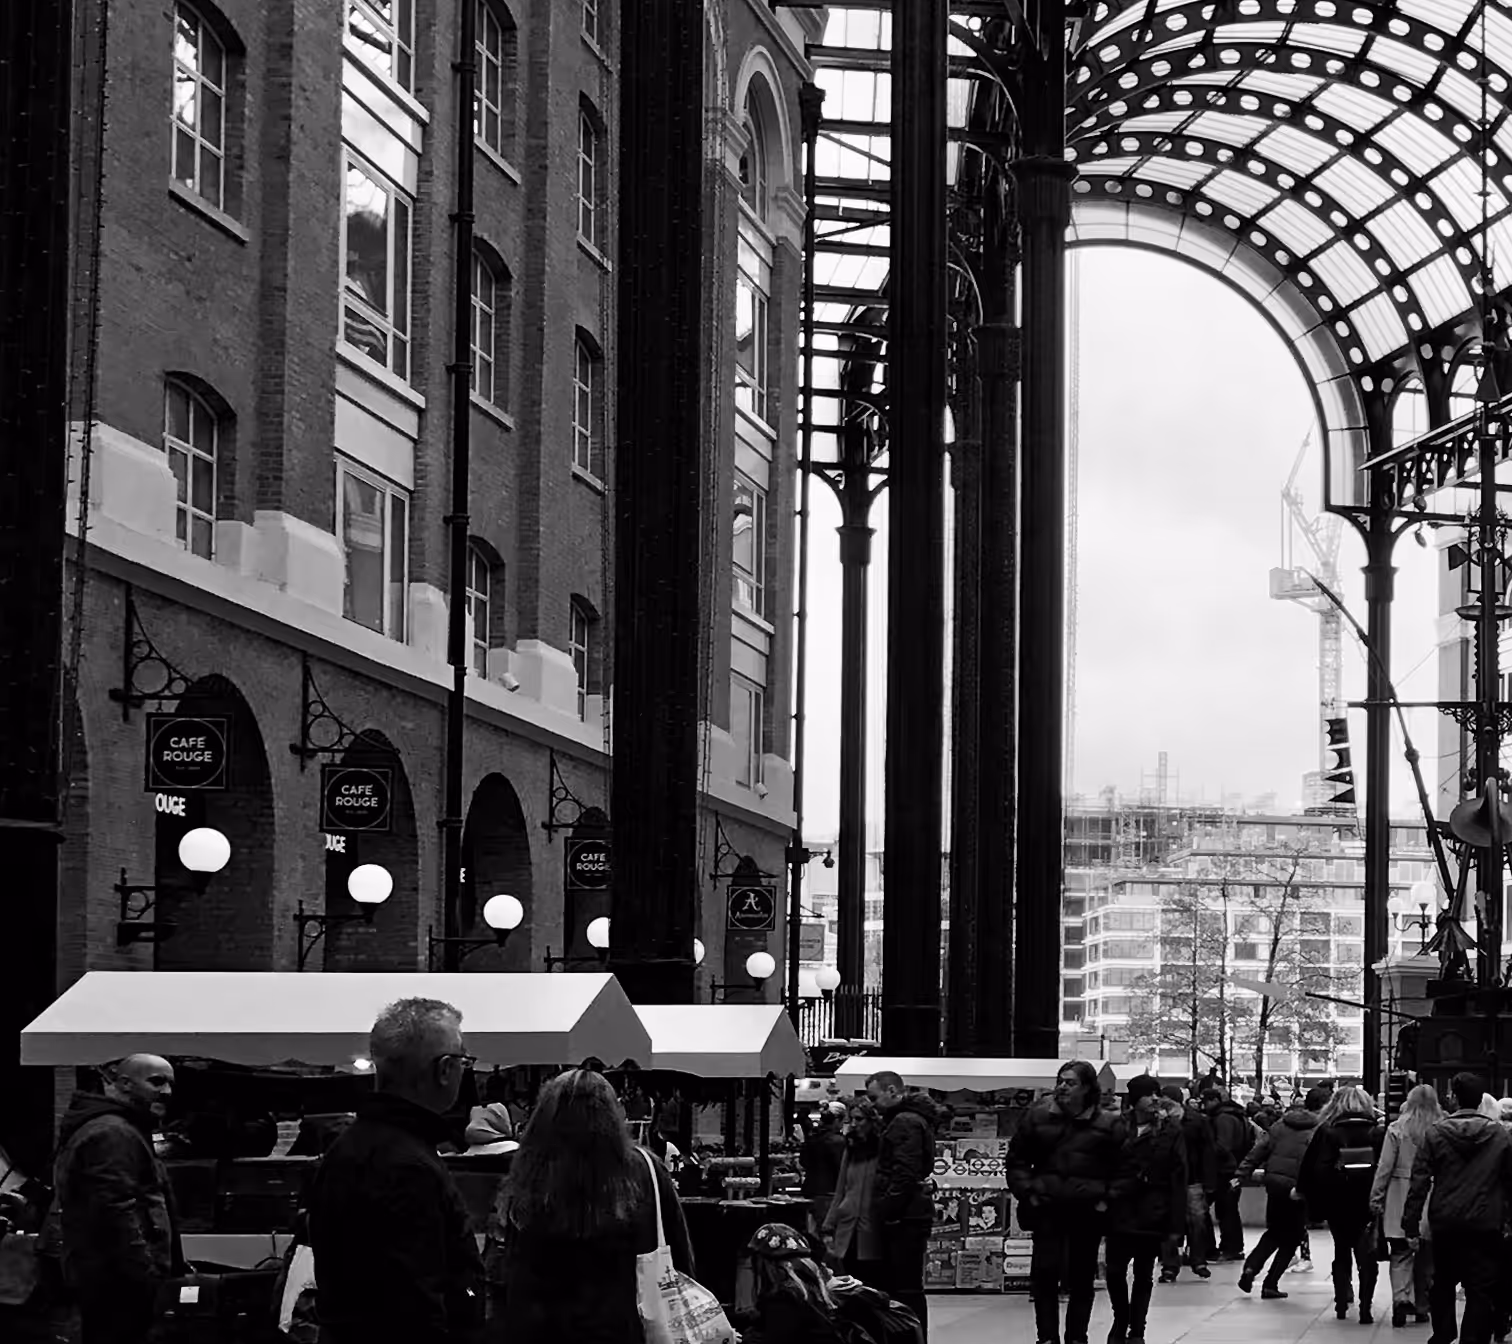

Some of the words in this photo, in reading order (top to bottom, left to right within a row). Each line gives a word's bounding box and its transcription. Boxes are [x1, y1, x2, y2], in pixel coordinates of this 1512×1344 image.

[163, 751, 212, 762] ROUGE
[155, 793, 186, 817] OUGE
[335, 797, 378, 807] ROUGE
